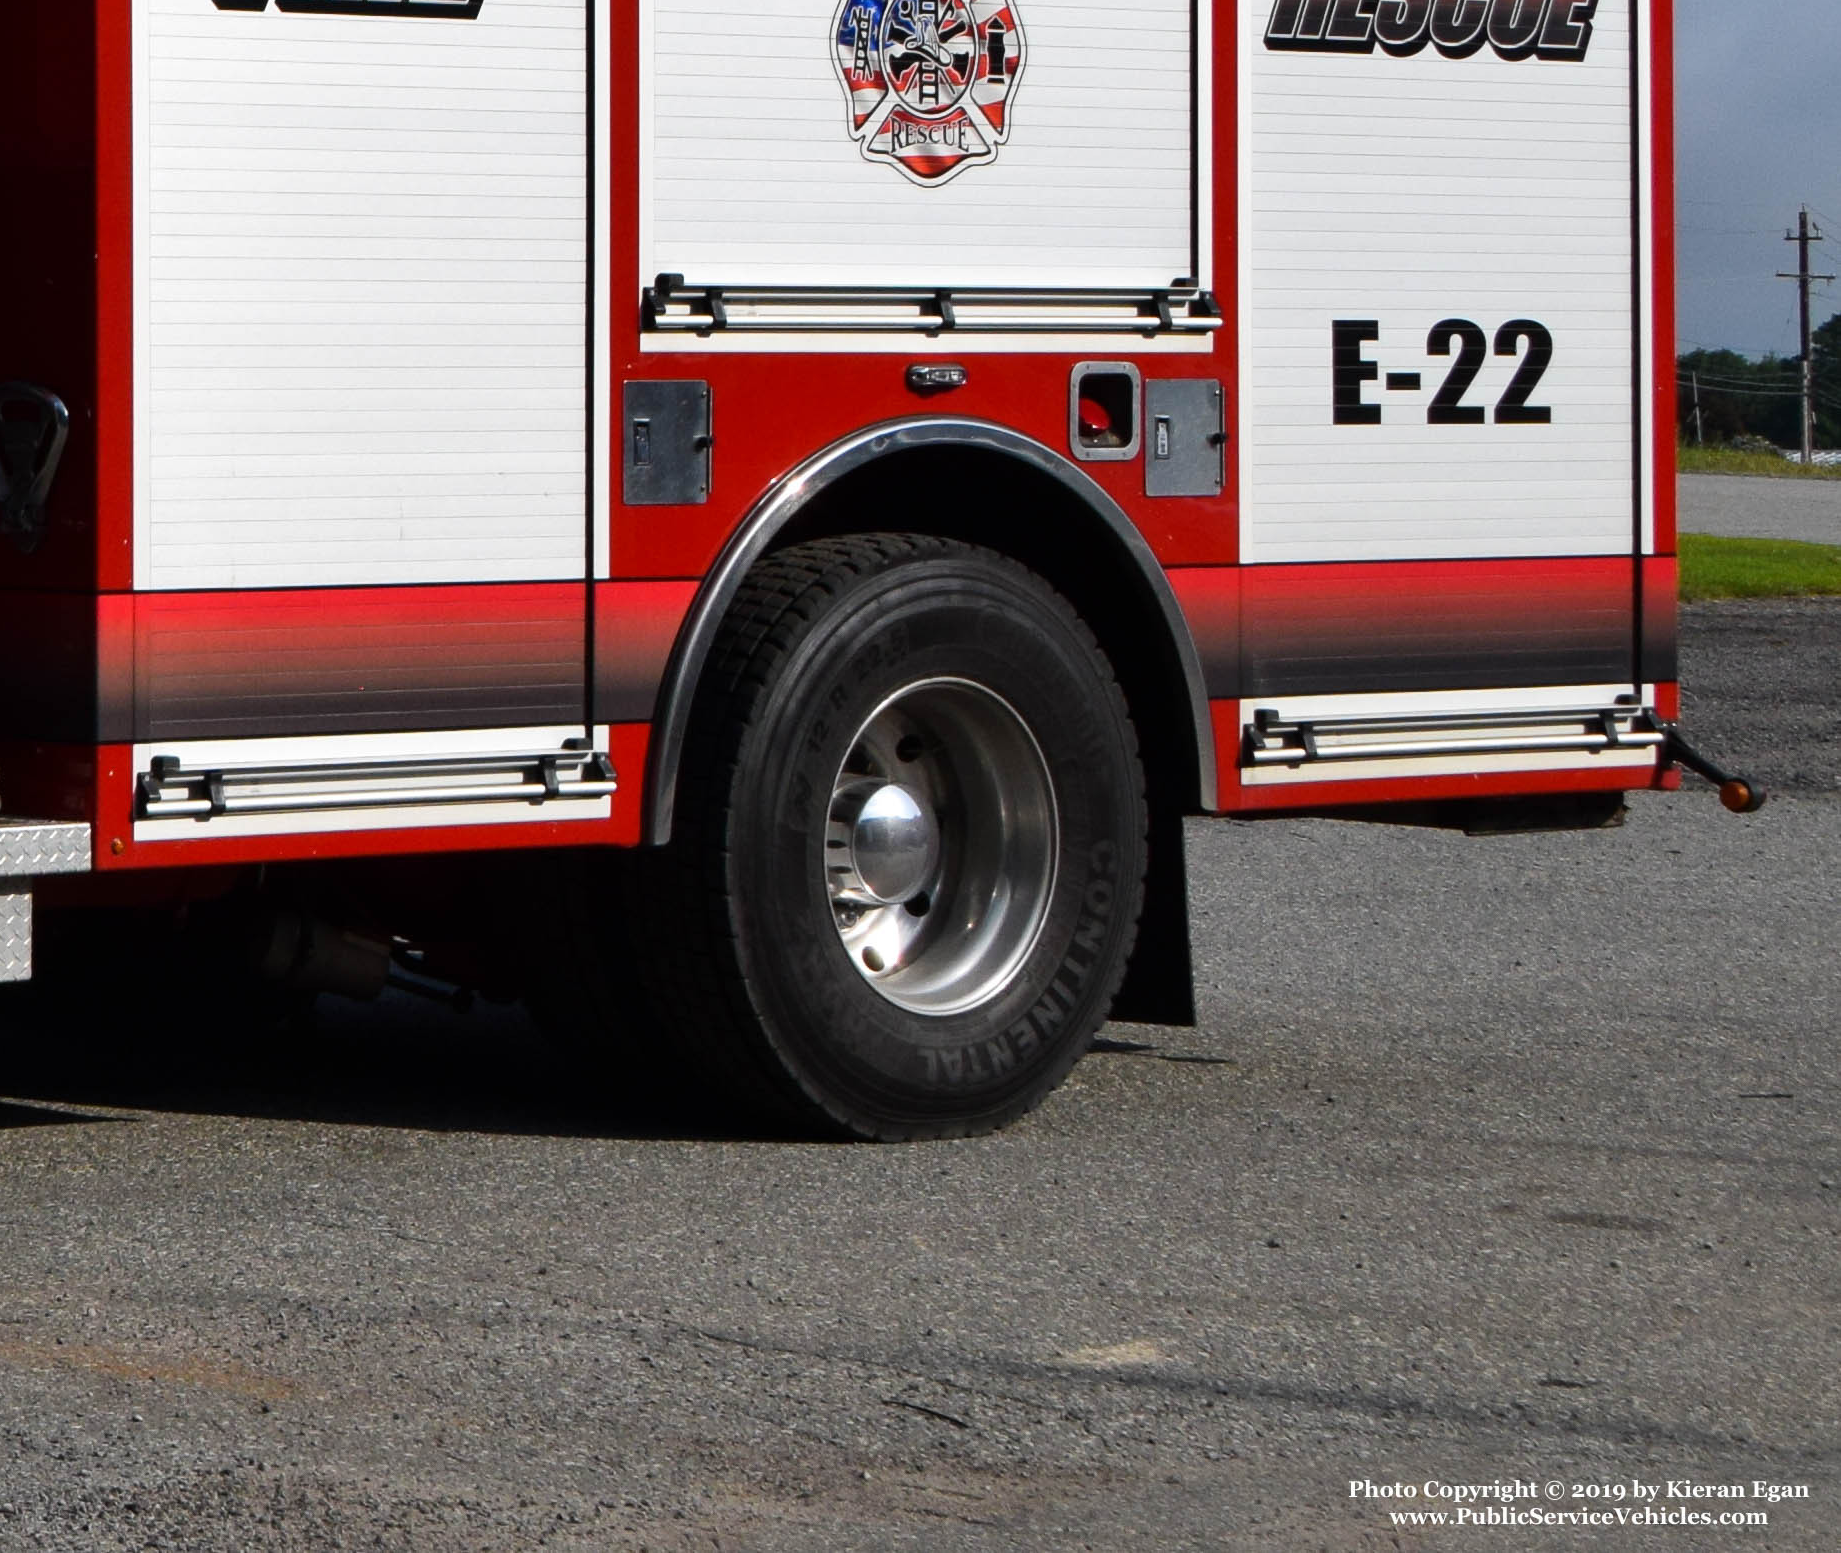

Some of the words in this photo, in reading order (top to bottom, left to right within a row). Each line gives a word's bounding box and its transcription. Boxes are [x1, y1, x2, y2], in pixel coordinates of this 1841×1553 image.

[890, 115, 970, 153] RESCUE
[1331, 318, 1554, 426] E-22
[917, 838, 1120, 1085] CONTINENTAL
